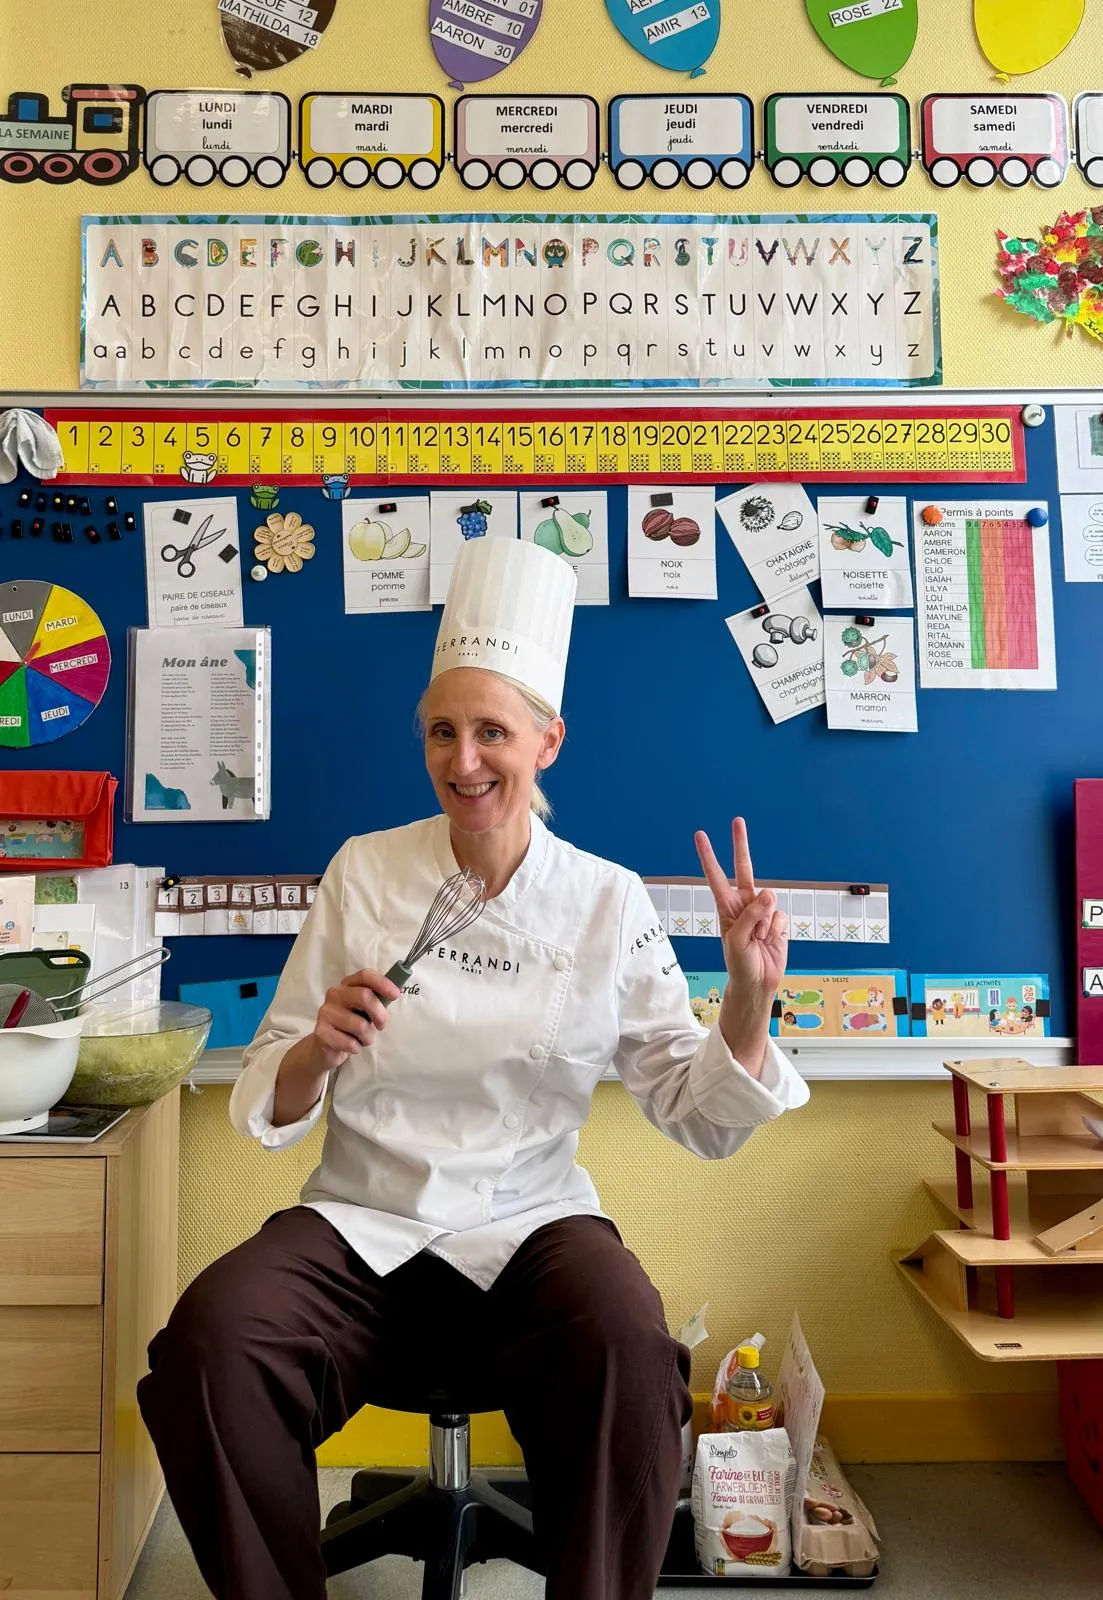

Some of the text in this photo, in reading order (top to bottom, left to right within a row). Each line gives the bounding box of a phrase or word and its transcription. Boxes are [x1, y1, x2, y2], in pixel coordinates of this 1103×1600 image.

[519, 2, 535, 15] 01
[831, 4, 872, 24] ROSE
[299, 8, 313, 23] 12
[444, 0, 522, 36] AMBRE 10
[220, 0, 290, 36] MATHILDA
[303, 32, 319, 46] 18
[647, 6, 707, 40] AMIR 13
[433, 20, 511, 59] AARON 30
[199, 102, 236, 113] LUNDI
[351, 104, 393, 115] MARDI
[496, 106, 558, 117] MERCREDI
[664, 104, 698, 114] JEUDI
[807, 104, 868, 114] VENDREDI
[970, 105, 1017, 115] SAMEDI
[202, 119, 232, 130] lundi
[354, 121, 390, 132] mardi
[500, 122, 553, 134] mercredi
[666, 118, 696, 131] jeudi
[812, 120, 864, 131] vendredi
[973, 121, 1016, 132] samedi
[16, 128, 70, 140] SEMAINE
[202, 137, 232, 150] lundi
[355, 142, 388, 152] mardi
[668, 135, 693, 152] jeudi
[818, 141, 859, 151] vendredi
[978, 144, 1013, 152] samedi
[506, 146, 548, 154] mercredi
[102, 291, 921, 317] A B C D E F G H I J K L M N O P Q R S T U V W X Y Z
[69, 422, 1010, 448] 1 2 3 4 5 6 7 8 9 10 11 12 13 14 15 16 17 18 19 20 21 22 23 24 25 26 27 28 29 30
[941, 507, 1014, 518] Permis à points
[923, 539, 953, 547] AMBRE
[766, 540, 814, 568] CHATAIGNE
[924, 548, 966, 556] CAMERON
[661, 560, 683, 568] NOIX
[774, 551, 816, 577] châtaigne
[924, 557, 953, 565] CHLOE
[371, 571, 405, 580] POMME
[663, 571, 681, 579] noix
[843, 571, 888, 579] NOISETTE
[371, 583, 406, 593] pomme
[162, 593, 185, 601] PAIRE
[200, 589, 235, 598] CISEAUX
[926, 594, 942, 602] LOU
[927, 604, 968, 612] MATHILDA
[4, 611, 33, 623] LUNDI
[46, 617, 77, 630] MARDI
[927, 623, 950, 631] REDA
[437, 636, 518, 655] FERRANDI
[929, 650, 952, 659] ROSE
[51, 655, 98, 673] MERCREDI
[162, 656, 228, 668] Mon âne
[850, 692, 891, 701] MARRON
[43, 708, 69, 720] JEUDI
[190, 893, 196, 905] 2
[214, 891, 221, 901] 3
[238, 891, 244, 902] 4
[261, 891, 268, 902] 5
[287, 891, 294, 902] 6
[708, 1465, 743, 1480] Farine
[711, 1482, 767, 1494] TARWEBLOEM
[711, 1492, 737, 1503] Farina
